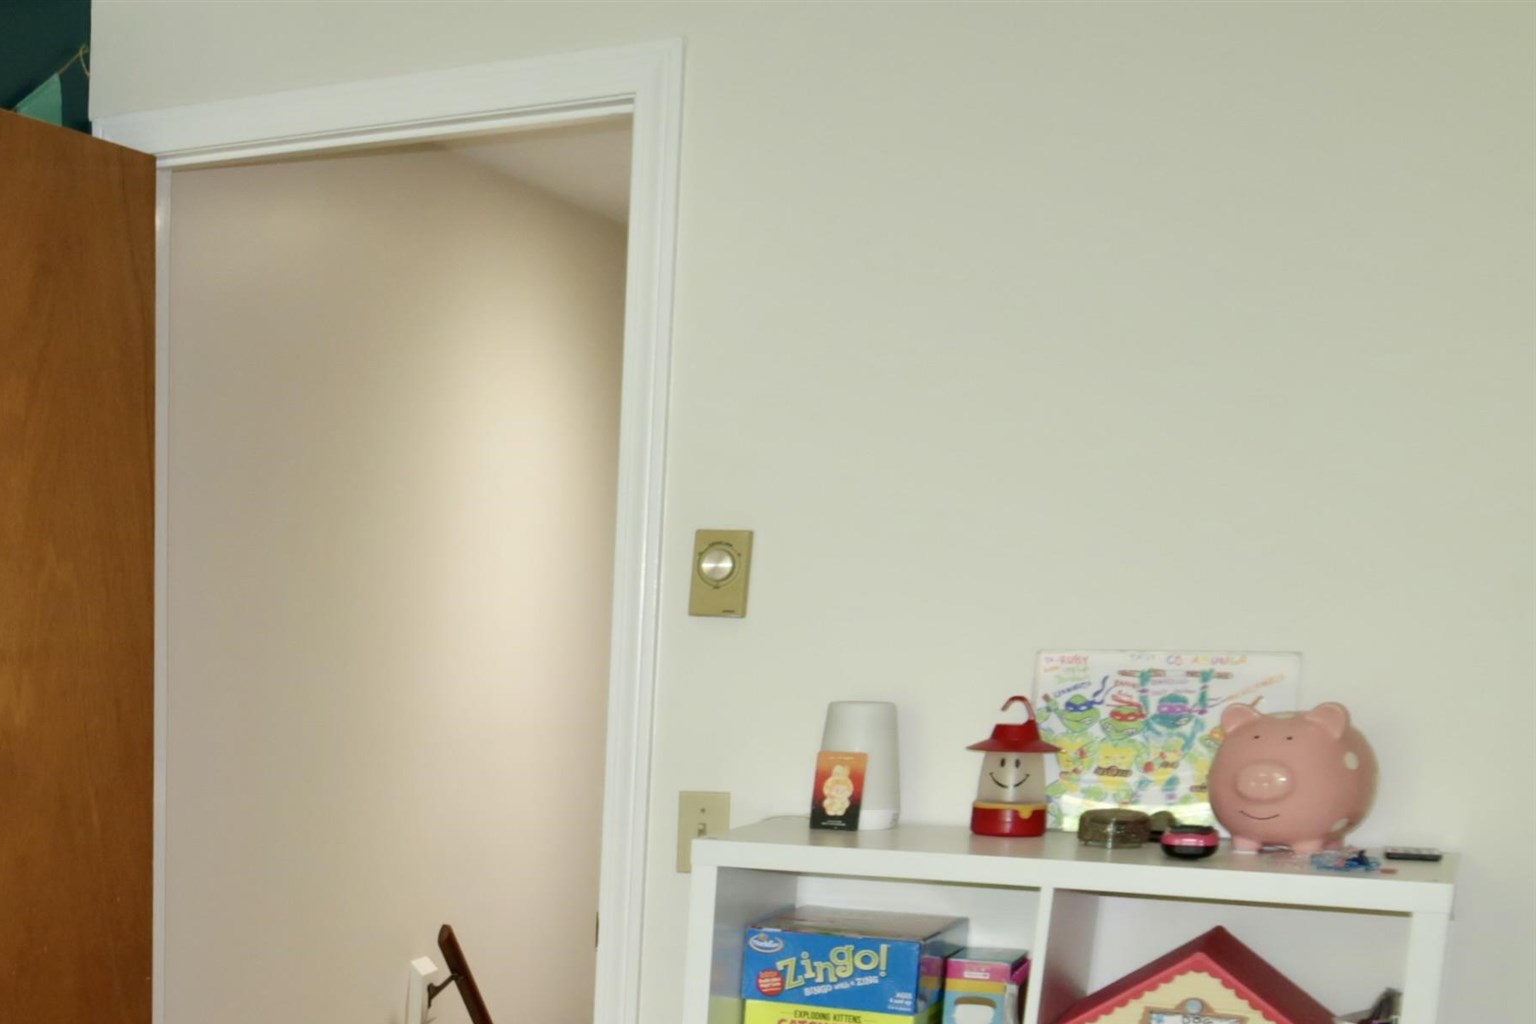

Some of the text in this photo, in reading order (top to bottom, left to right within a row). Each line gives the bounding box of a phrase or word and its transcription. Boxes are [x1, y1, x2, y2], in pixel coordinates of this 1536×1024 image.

[776, 944, 889, 990] Zingo!
[794, 1010, 863, 1024] EXPLODING KITTENS
